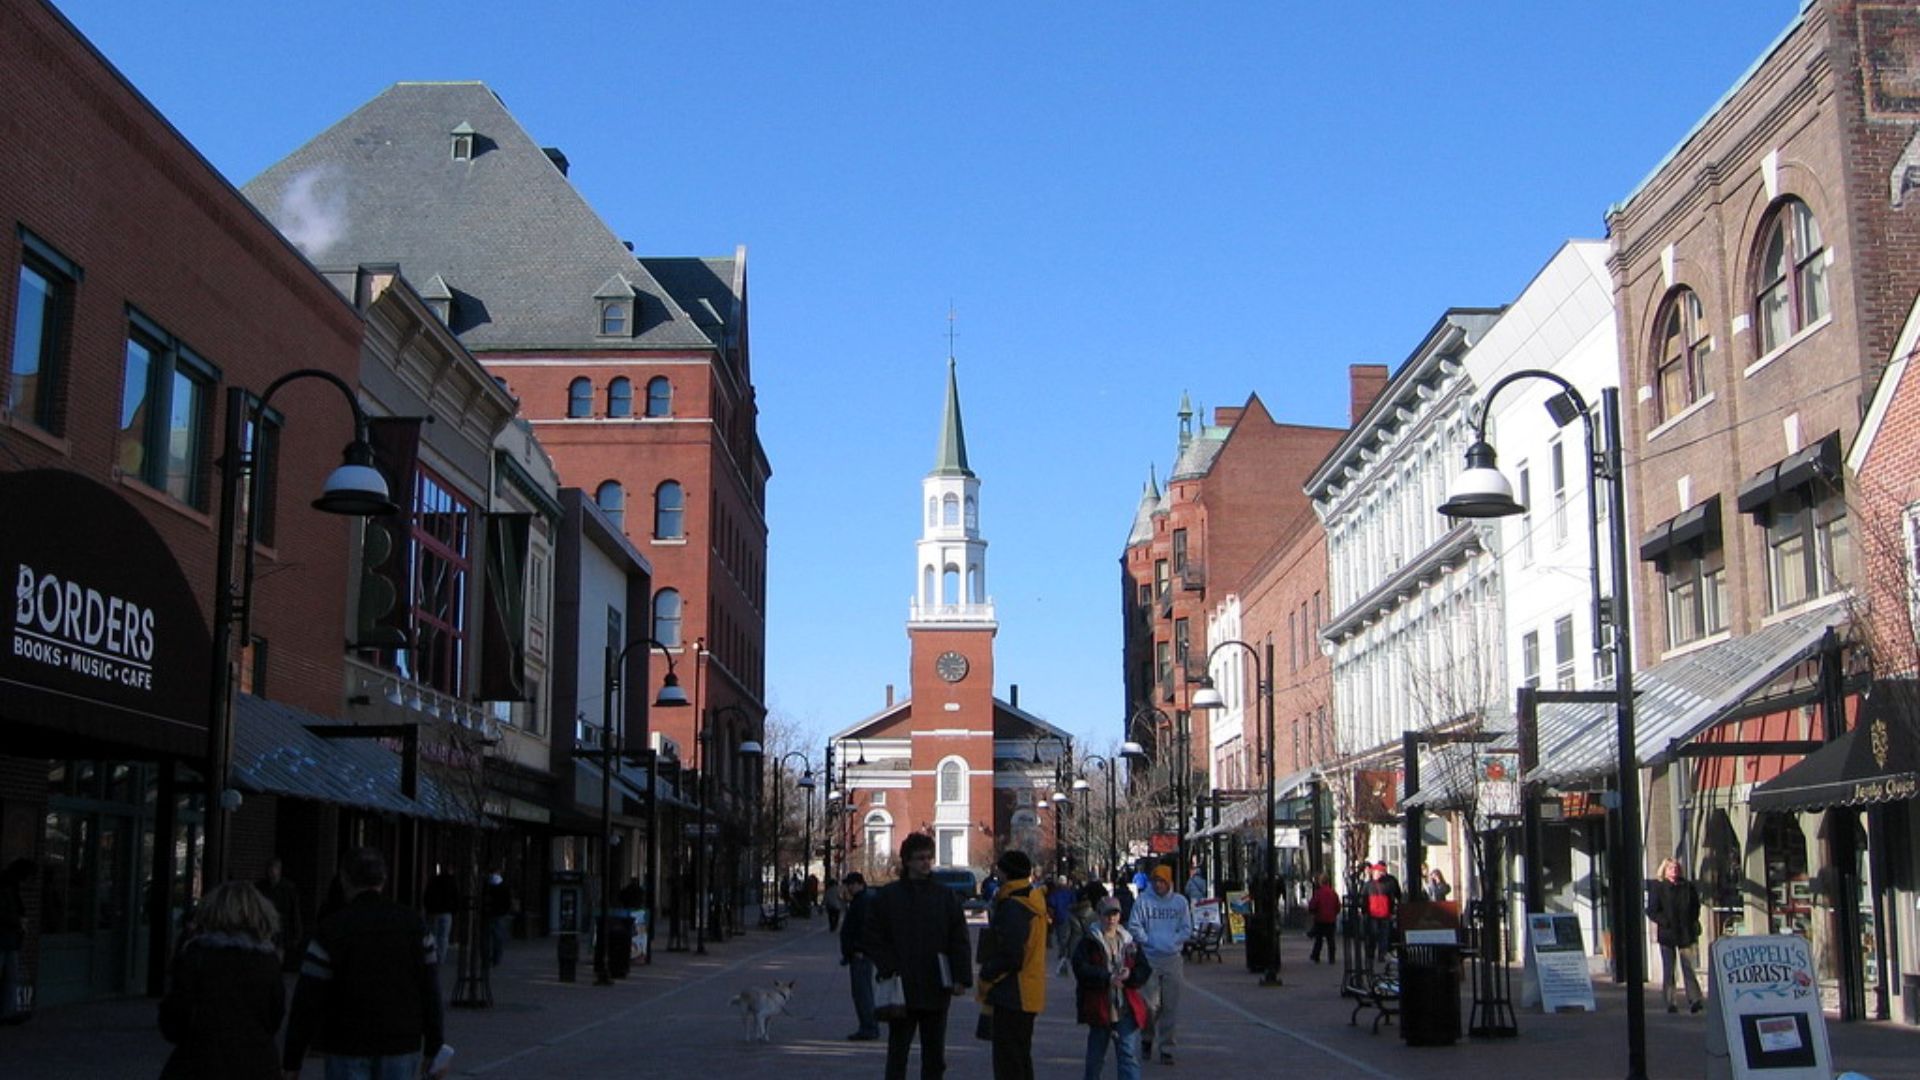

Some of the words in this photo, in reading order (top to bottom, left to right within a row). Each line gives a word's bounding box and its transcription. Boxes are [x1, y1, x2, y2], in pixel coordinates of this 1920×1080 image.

[16, 563, 155, 661] BORDERS
[15, 637, 62, 666] BOOKS
[71, 653, 112, 680] MUSIC
[121, 668, 152, 690] CAFE
[1723, 945, 1807, 968] CHAPPELL'S
[1728, 963, 1791, 983] FLORIST
